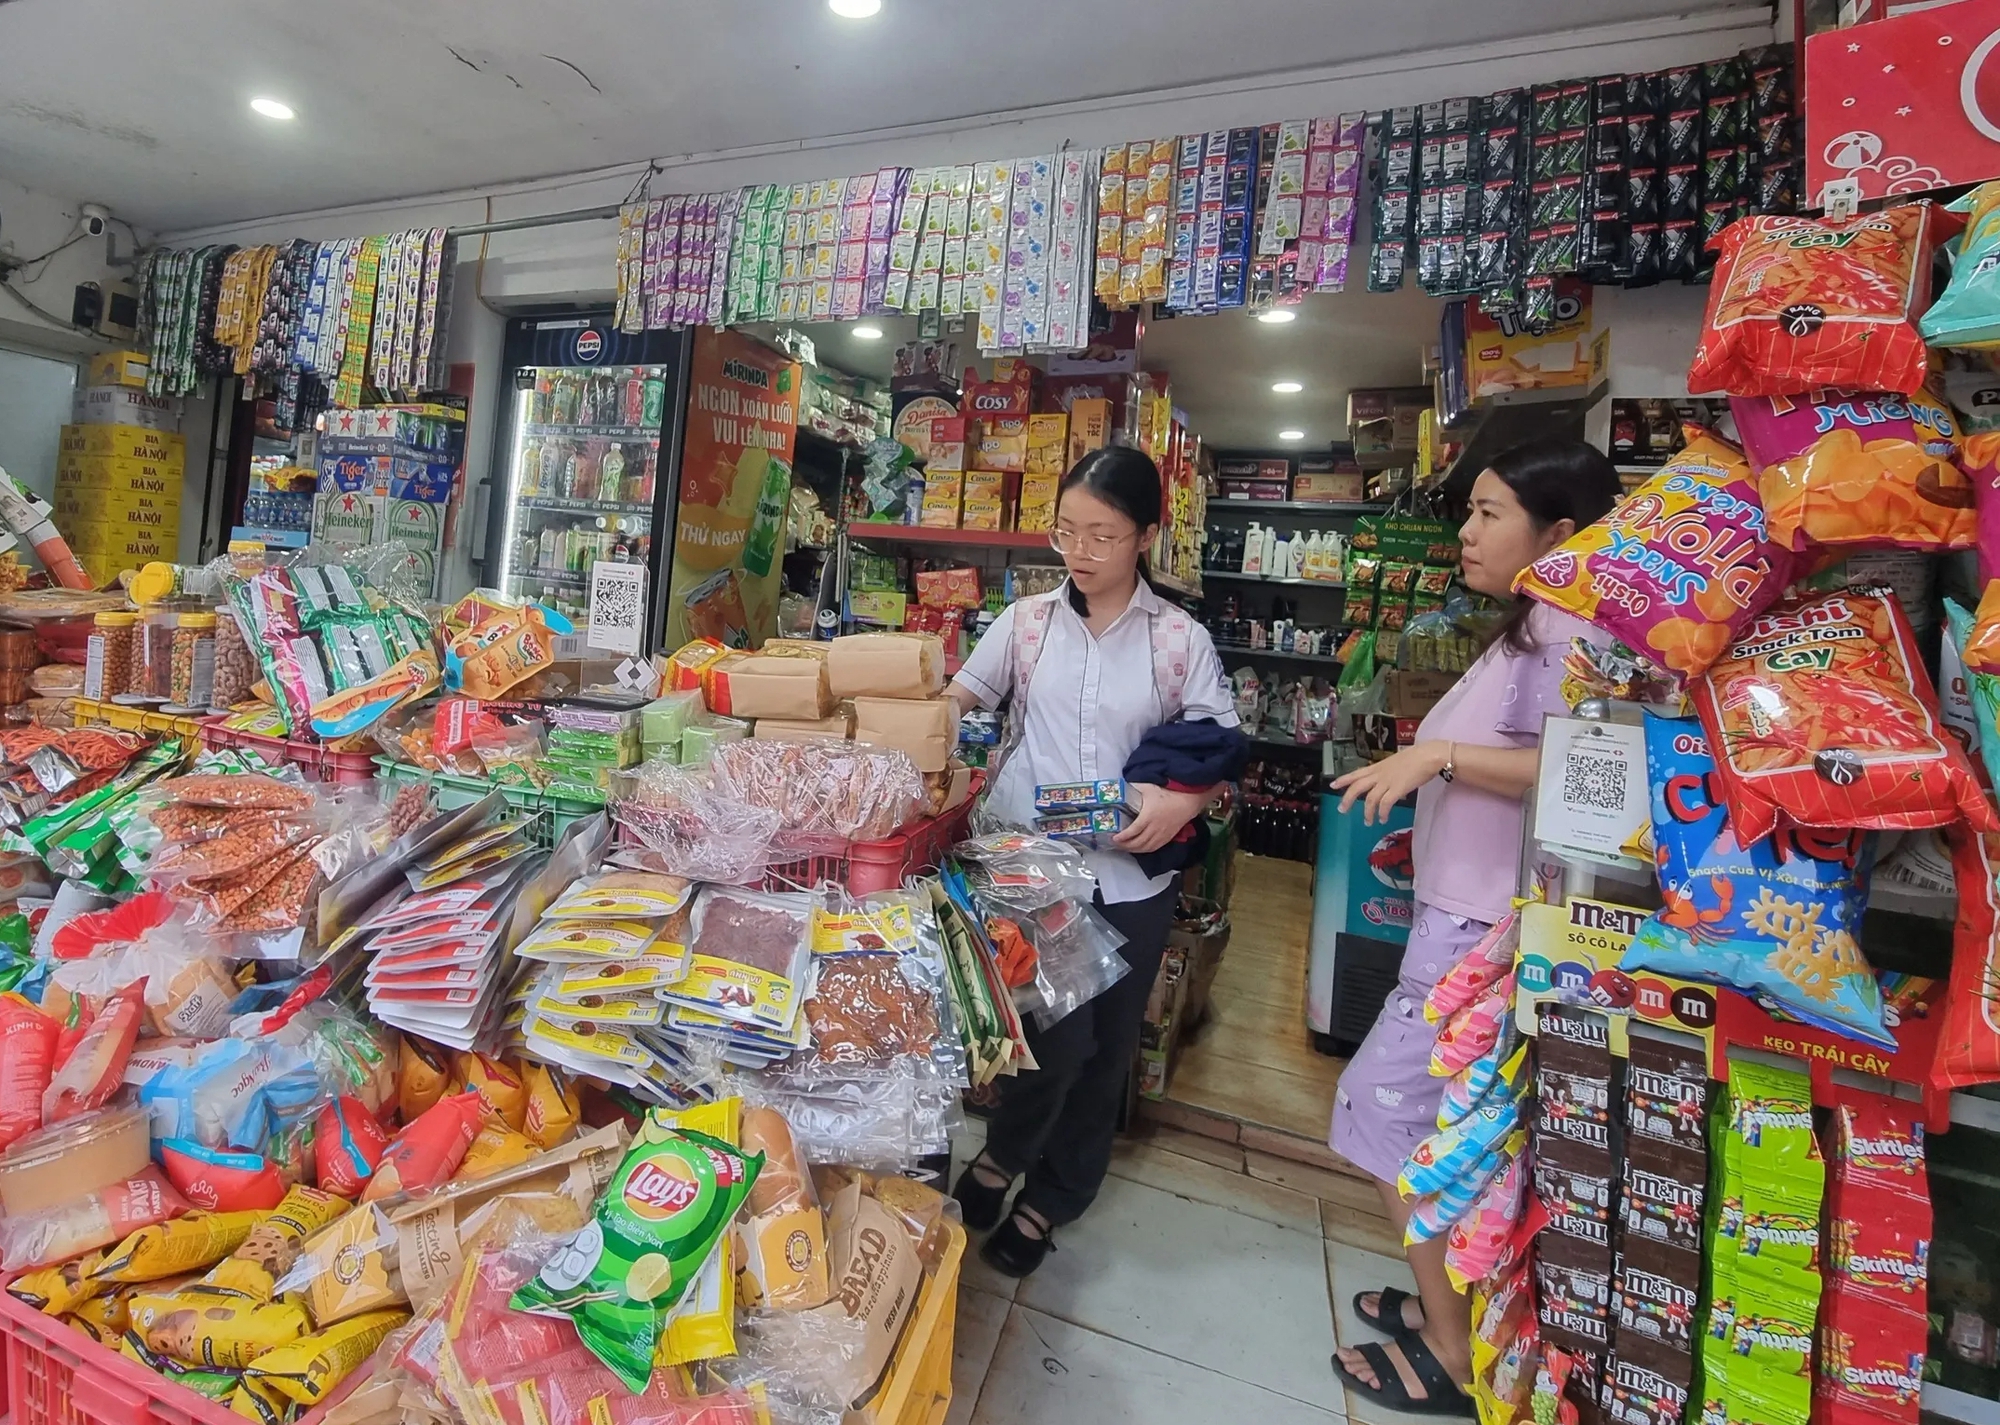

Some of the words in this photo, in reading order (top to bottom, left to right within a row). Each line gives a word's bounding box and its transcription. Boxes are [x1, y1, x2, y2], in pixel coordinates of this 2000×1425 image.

[1424, 123, 1433, 133] 5
[1447, 121, 1456, 131] 5
[1790, 305, 1821, 317] RANG
[578, 342, 600, 350] PEPSI
[698, 383, 740, 416] NGON
[975, 395, 1012, 411] COSY
[906, 405, 949, 426] Danisa
[1356, 407, 1385, 416] VIFON
[609, 428, 626, 436] PEPSI
[712, 416, 738, 446] VUI
[740, 424, 761, 448] LÊN
[762, 431, 786, 451] NHA!
[1000, 419, 1022, 429] Tipo
[145, 434, 159, 444] BIA
[143, 466, 157, 476] BIA
[340, 461, 366, 481] Tiger
[414, 484, 436, 499] Tiger
[139, 498, 153, 508] BIA
[324, 511, 374, 529] Heineken
[138, 530, 152, 540] BIA
[391, 525, 435, 541] Heineken
[680, 521, 709, 545] THỬ
[711, 529, 747, 547] NGAY
[1591, 572, 1650, 617] Oishi
[1732, 633, 1801, 659] Snack
[1809, 627, 1863, 641] Tôm
[1765, 647, 1834, 672] Cay
[1819, 749, 1854, 761] RANG
[1688, 866, 1724, 878] Snack
[1729, 865, 1755, 876] Cua
[1759, 866, 1773, 882] Vị
[1567, 931, 1586, 947] SÔ
[1588, 934, 1608, 949] CÔ
[1610, 941, 1628, 952] LA
[178, 994, 203, 1023] Staff
[4, 1022, 29, 1036] KINH
[1763, 1034, 1796, 1054] KẸO
[1800, 1039, 1847, 1063] TRÁI
[1849, 1052, 1891, 1076] CÂY
[1743, 1110, 1813, 1130] Skittles
[1850, 1137, 1925, 1160] Skittles
[629, 1163, 696, 1208] Lay's
[603, 1208, 614, 1221] Vị
[612, 1211, 628, 1228] Tảo
[1744, 1224, 1820, 1247] Skittles
[839, 1227, 888, 1319] BREAD
[1849, 1255, 1927, 1280] Skittles
[883, 1308, 899, 1334] FRESH
[1736, 1325, 1812, 1354] Skittles
[1844, 1367, 1922, 1392] Skittles
